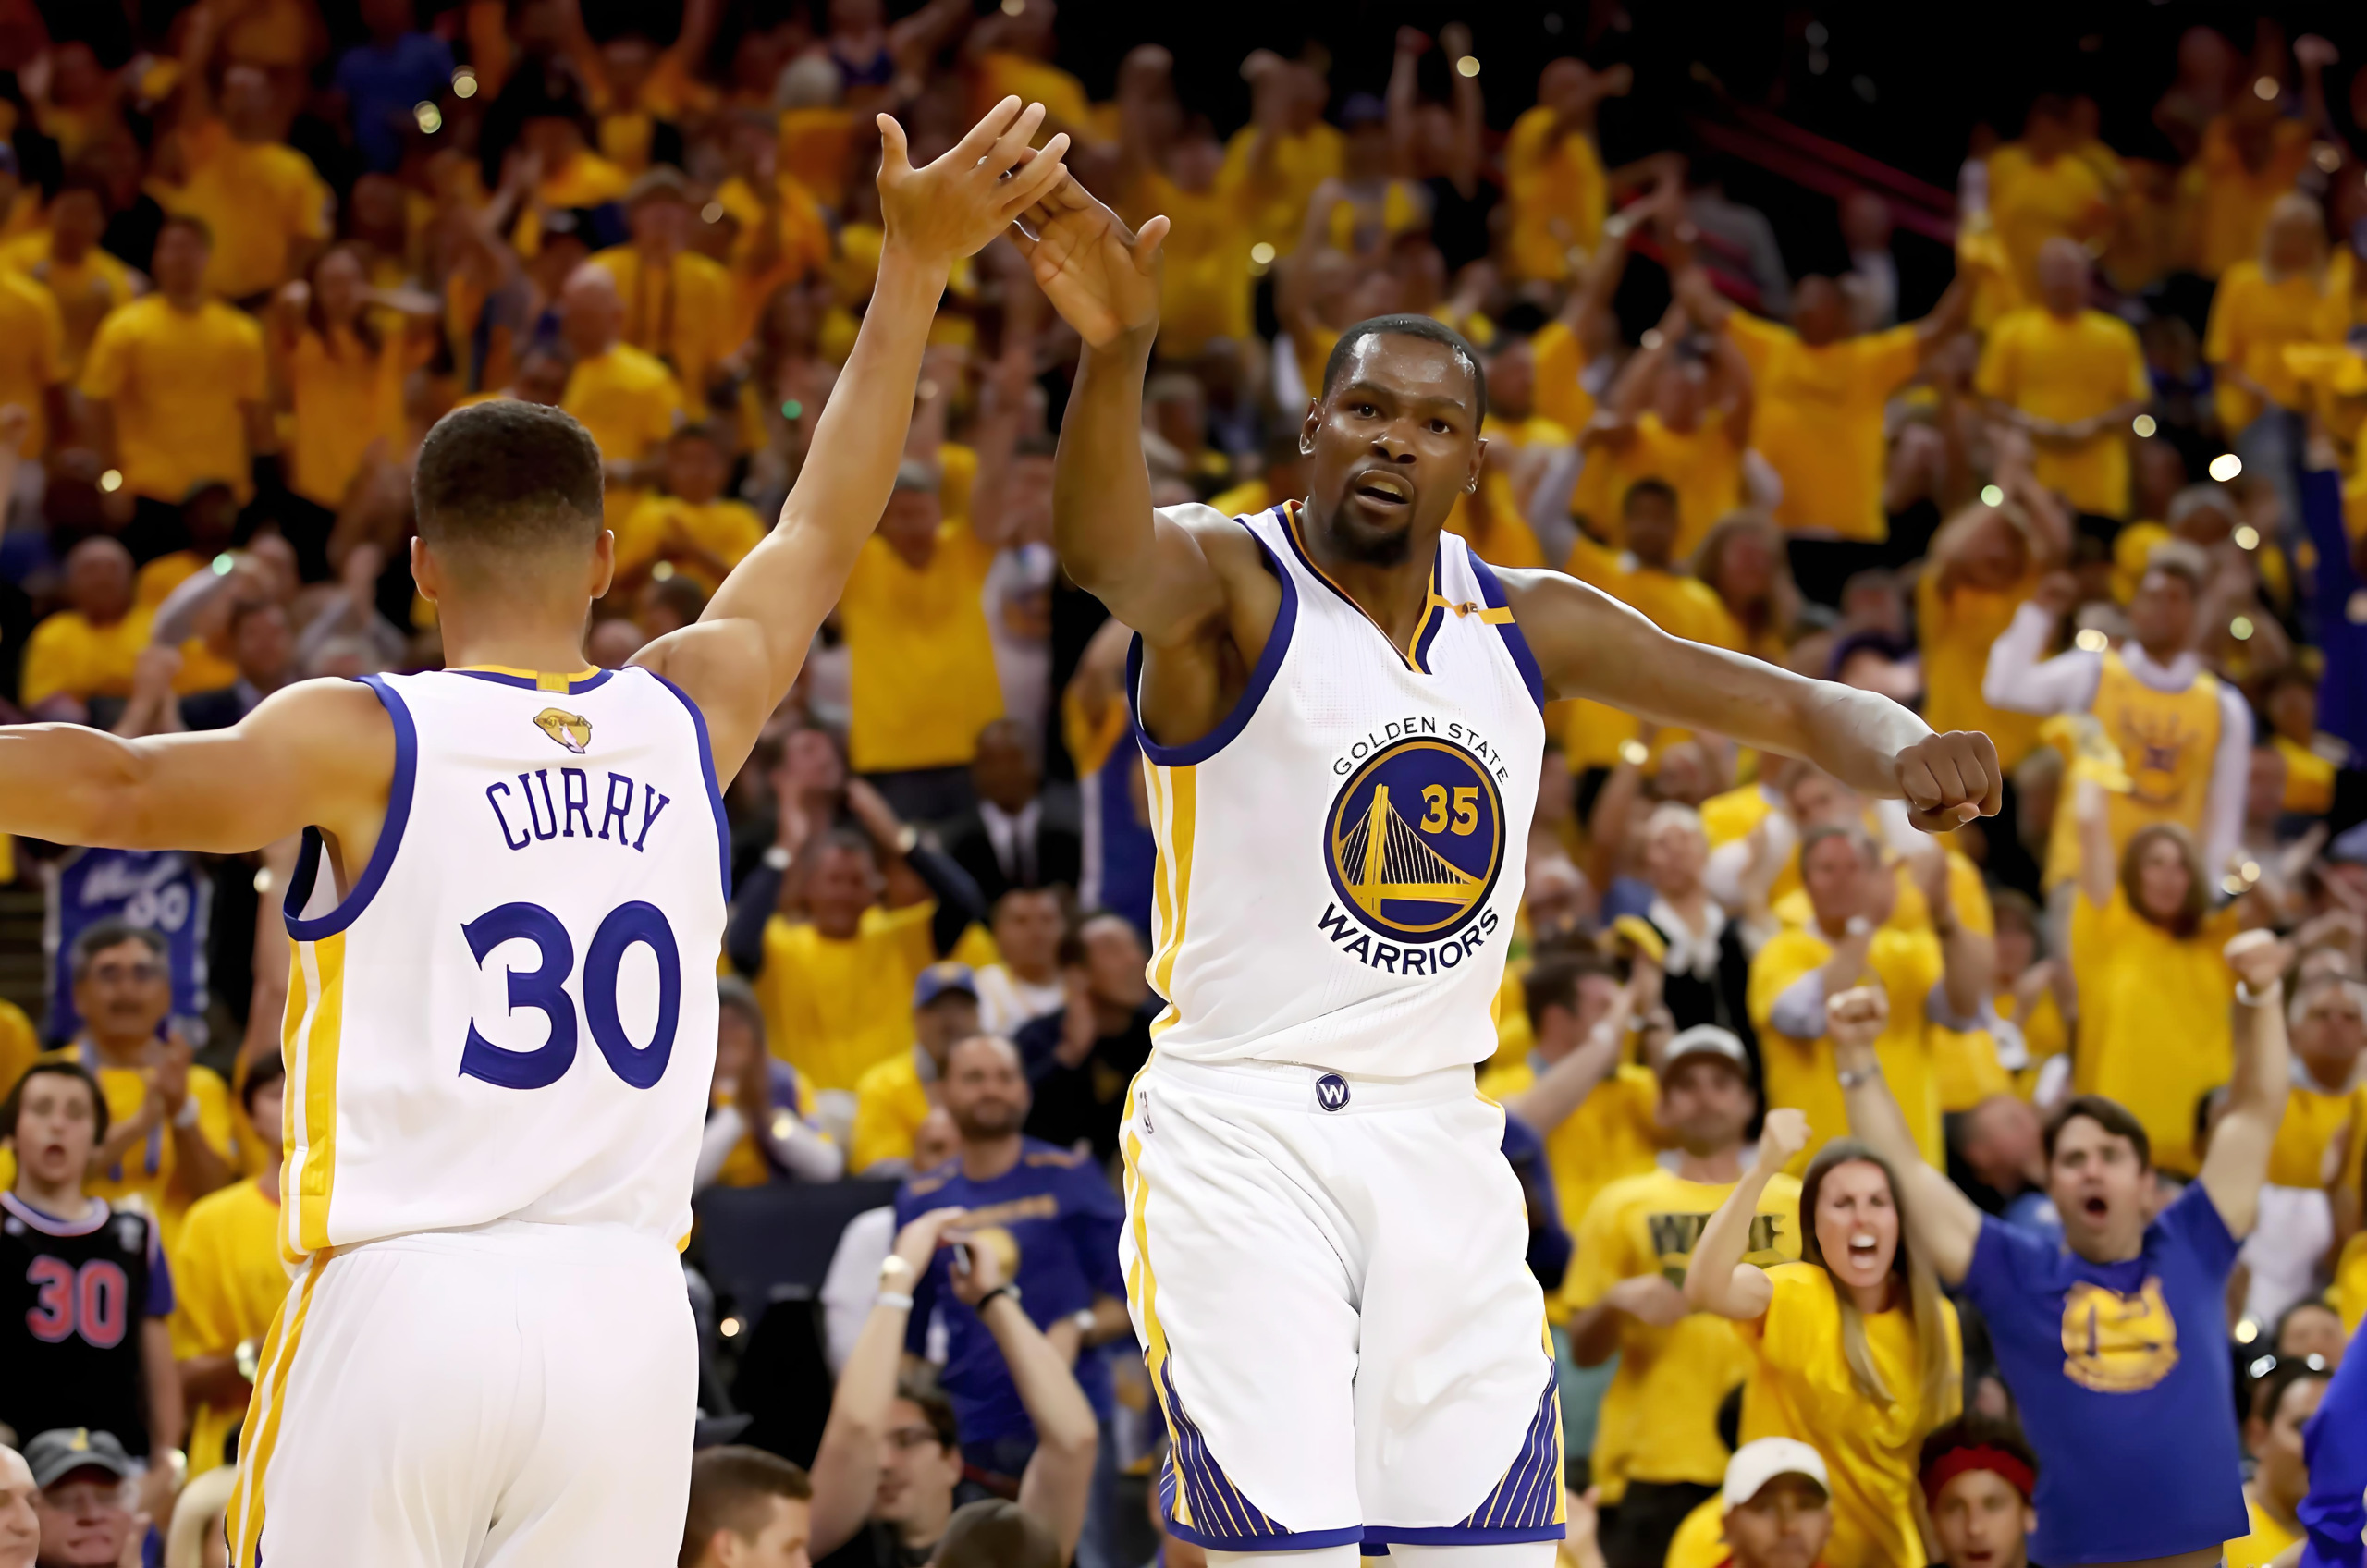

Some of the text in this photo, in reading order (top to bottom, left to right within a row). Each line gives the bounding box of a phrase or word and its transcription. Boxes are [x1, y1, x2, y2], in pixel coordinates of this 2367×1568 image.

[1333, 717, 1508, 785] GOLDEN STATE
[485, 767, 670, 852] CURRY
[1419, 784, 1478, 836] 35
[1317, 901, 1499, 975] WARRIORS
[458, 900, 681, 1089] 30
[1318, 1083, 1345, 1103] W
[25, 1254, 128, 1349] 30
